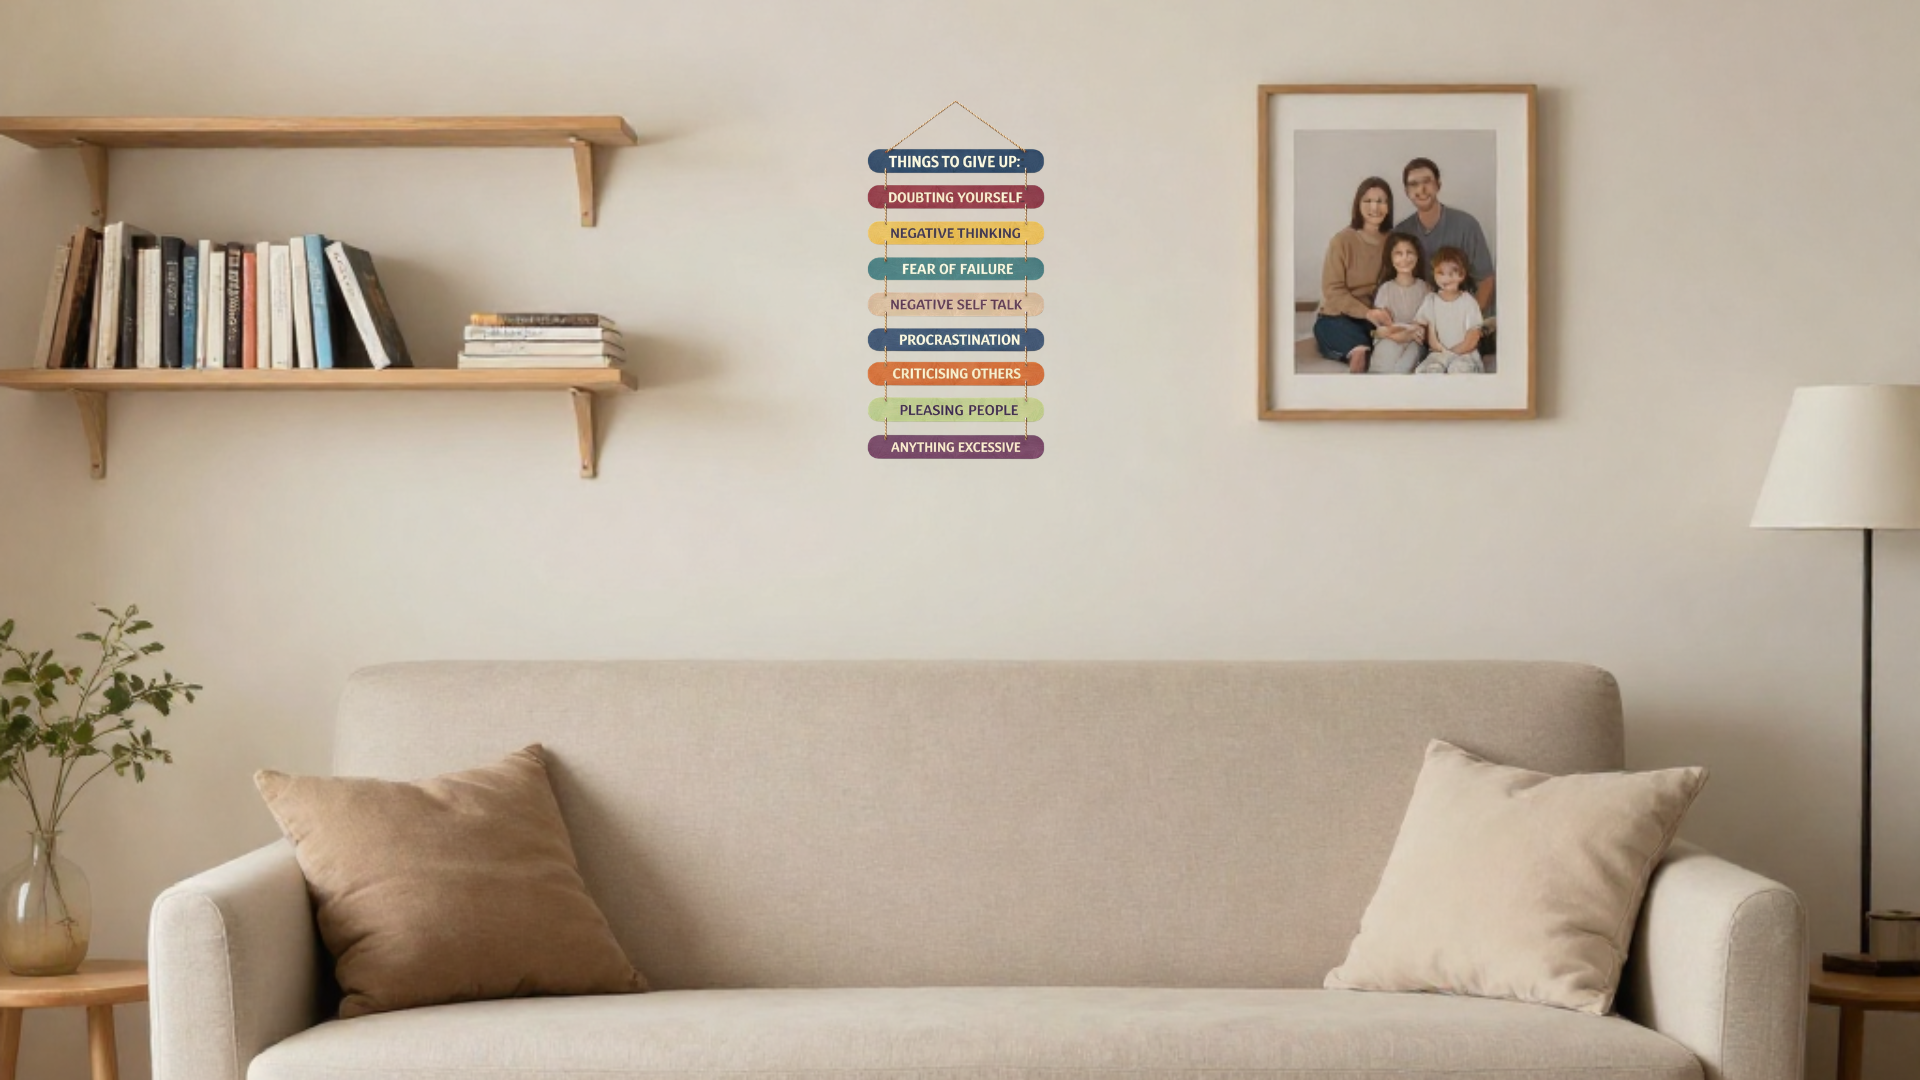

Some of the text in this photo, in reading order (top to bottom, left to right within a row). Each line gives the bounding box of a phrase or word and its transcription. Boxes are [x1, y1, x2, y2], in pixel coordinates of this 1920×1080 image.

[889, 156, 1021, 167] THINGS TO GIVE UP:
[888, 192, 1023, 203] DOUBTING YOURSELF
[891, 228, 1021, 238] NEGATIVE THINKING
[902, 264, 1013, 274] FEAR OF FAILURE
[891, 300, 1022, 310] NEGATIVE SELF TALK
[900, 334, 1020, 345] PROCRASTINATION
[893, 368, 1021, 379] CRITICISING OTHERS
[900, 405, 1018, 415] PLEASING PEOPLE
[891, 442, 1020, 452] ANYTHING EXCESSIVE
